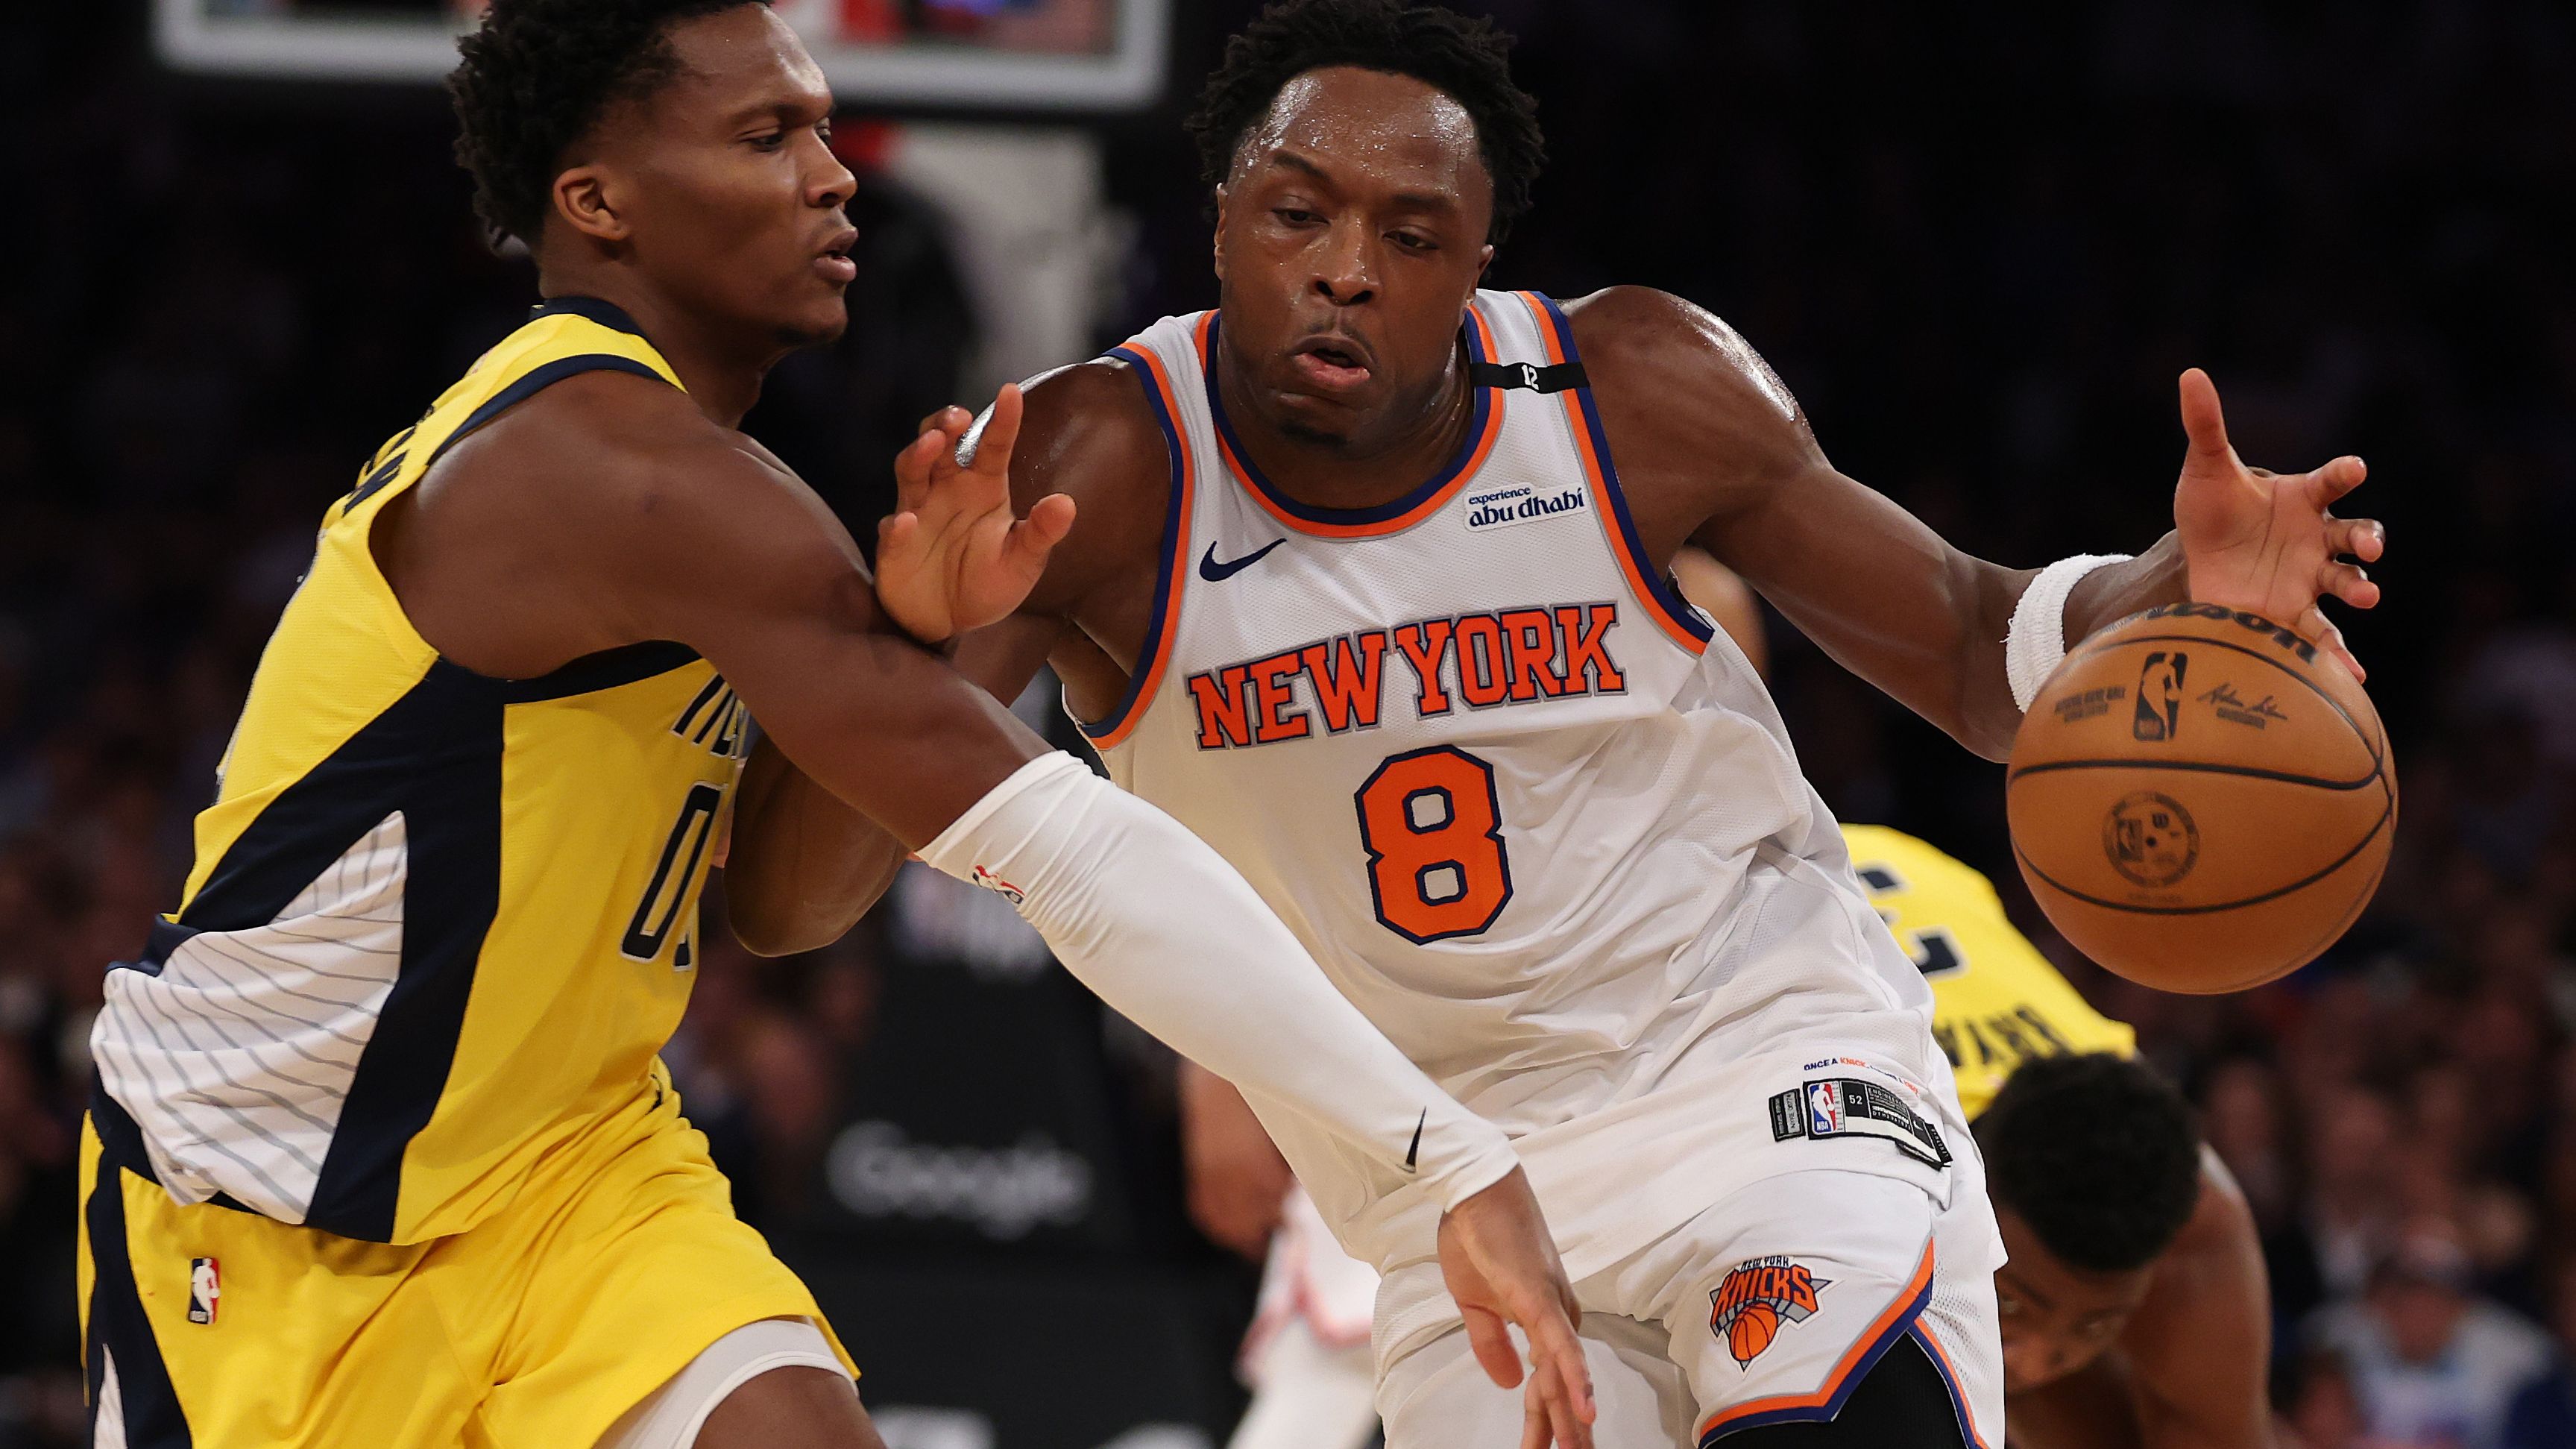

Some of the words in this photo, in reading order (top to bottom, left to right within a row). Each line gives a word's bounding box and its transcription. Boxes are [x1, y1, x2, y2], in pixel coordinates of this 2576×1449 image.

[1522, 364, 1540, 391] 12
[1469, 487, 1531, 512] experience
[1470, 505, 1515, 527] abu
[1518, 487, 1585, 518] dhabi
[1185, 626, 1391, 751] NEW
[1391, 600, 1628, 720] YORK
[1354, 744, 1514, 945] 8
[1804, 1057, 1830, 1071] ONCE
[1848, 1094, 1863, 1105] 52
[1816, 1119, 1829, 1131] NBA
[1740, 1257, 1761, 1273] NEW
[1763, 1254, 1789, 1268] YORK
[1710, 1264, 1818, 1331] KNICKS
